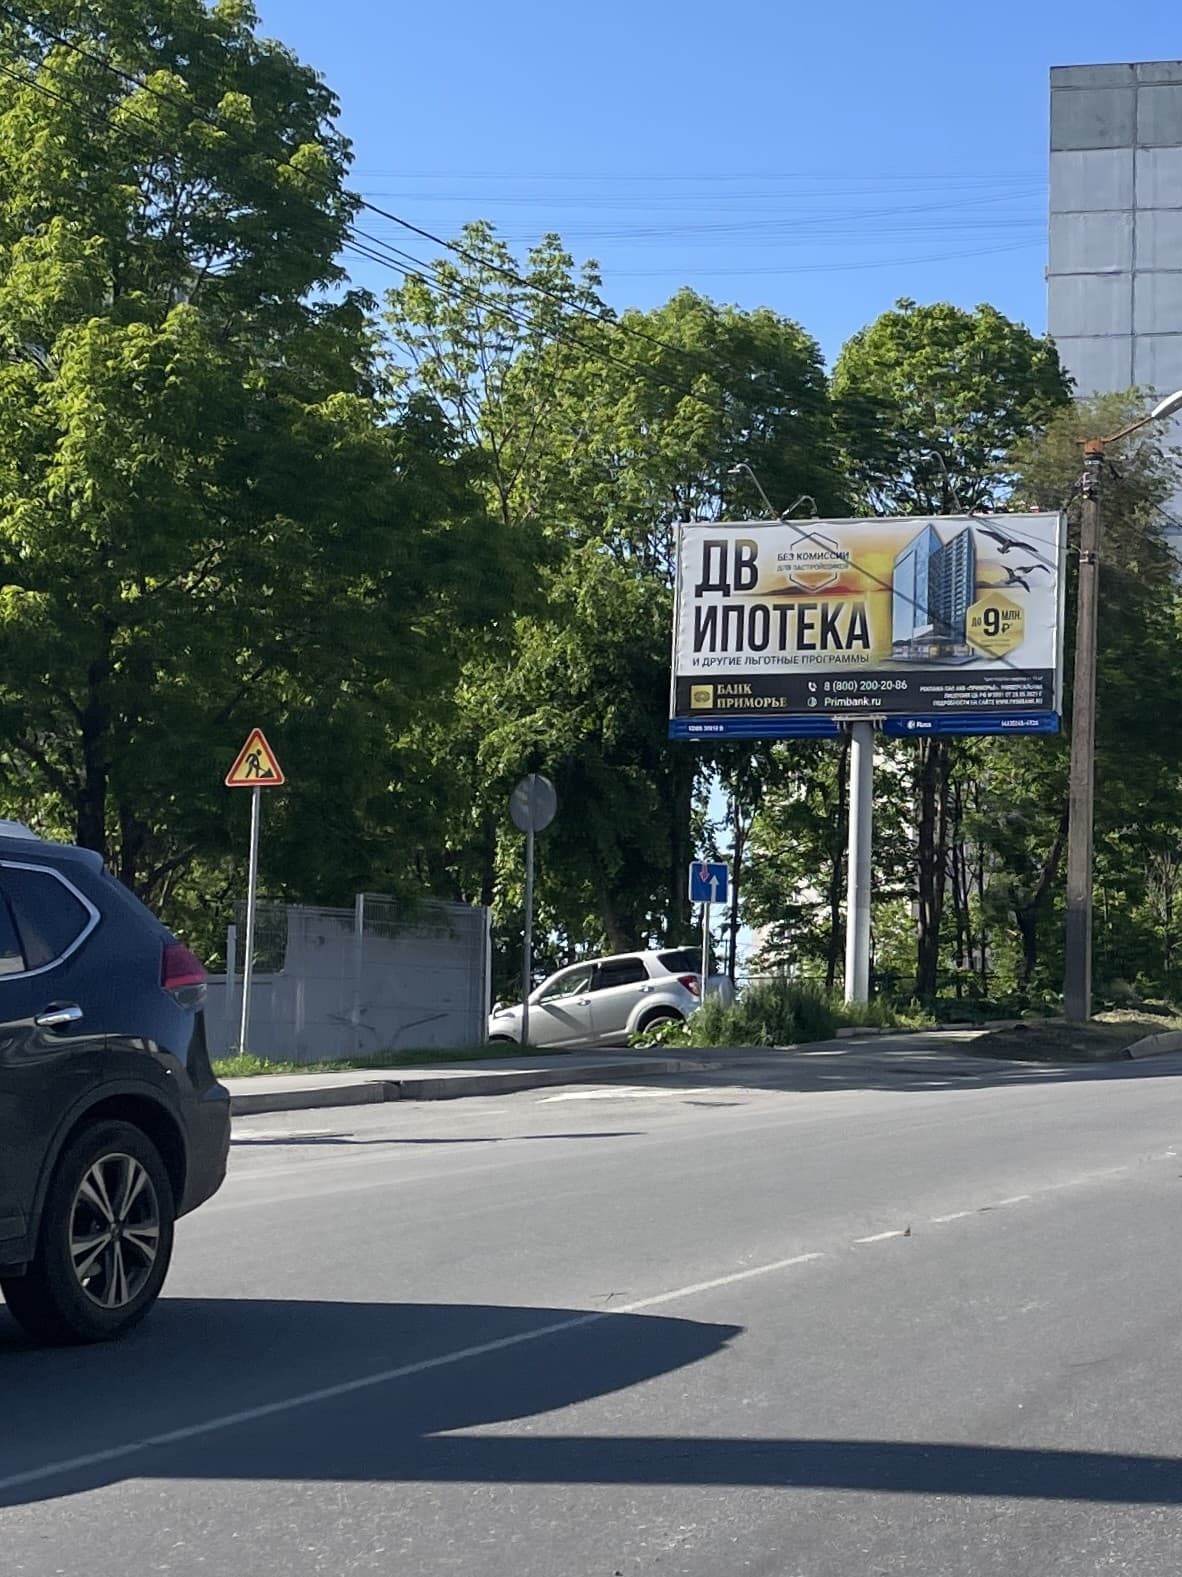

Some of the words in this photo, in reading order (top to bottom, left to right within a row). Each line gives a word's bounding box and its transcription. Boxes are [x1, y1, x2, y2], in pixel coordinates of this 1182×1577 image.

[777, 553, 794, 561] БЕЗ
[796, 551, 850, 561] КОМИССИИ
[695, 539, 759, 598] ДВ
[693, 602, 870, 653] ИПОТЕКА
[983, 607, 1000, 637] 9
[693, 658, 700, 667] И
[702, 656, 741, 667] ДРУГИЕ
[744, 655, 799, 665] ЛЬГОТНЫЕ
[801, 654, 869, 665] ПРОГРАММЫ
[717, 683, 752, 695] БАНК
[824, 681, 831, 691] 8
[833, 680, 858, 692] (800)
[860, 680, 908, 691] 200-20-86
[717, 696, 787, 709] ПРИМОРЬЕ
[824, 696, 881, 707] Primbank.ru
